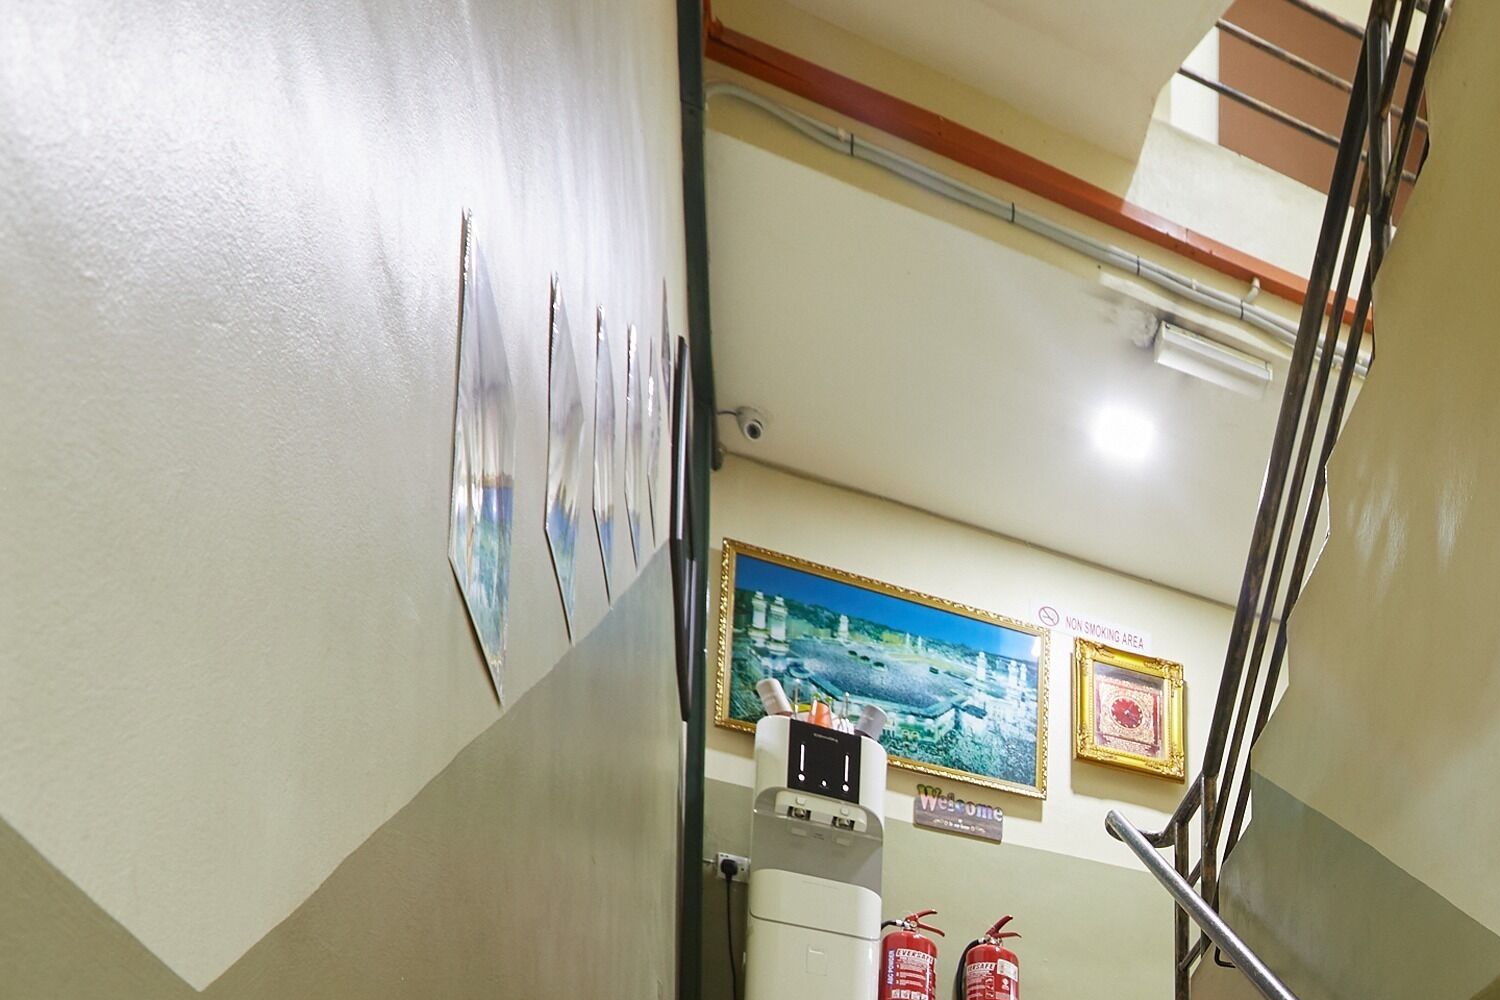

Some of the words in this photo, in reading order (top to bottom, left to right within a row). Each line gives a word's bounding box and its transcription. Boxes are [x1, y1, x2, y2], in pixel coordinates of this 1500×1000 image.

[1066, 616, 1082, 632] NON
[1084, 621, 1120, 643] SMOKING
[1122, 632, 1144, 649] AREA
[917, 784, 1003, 821] Welcome
